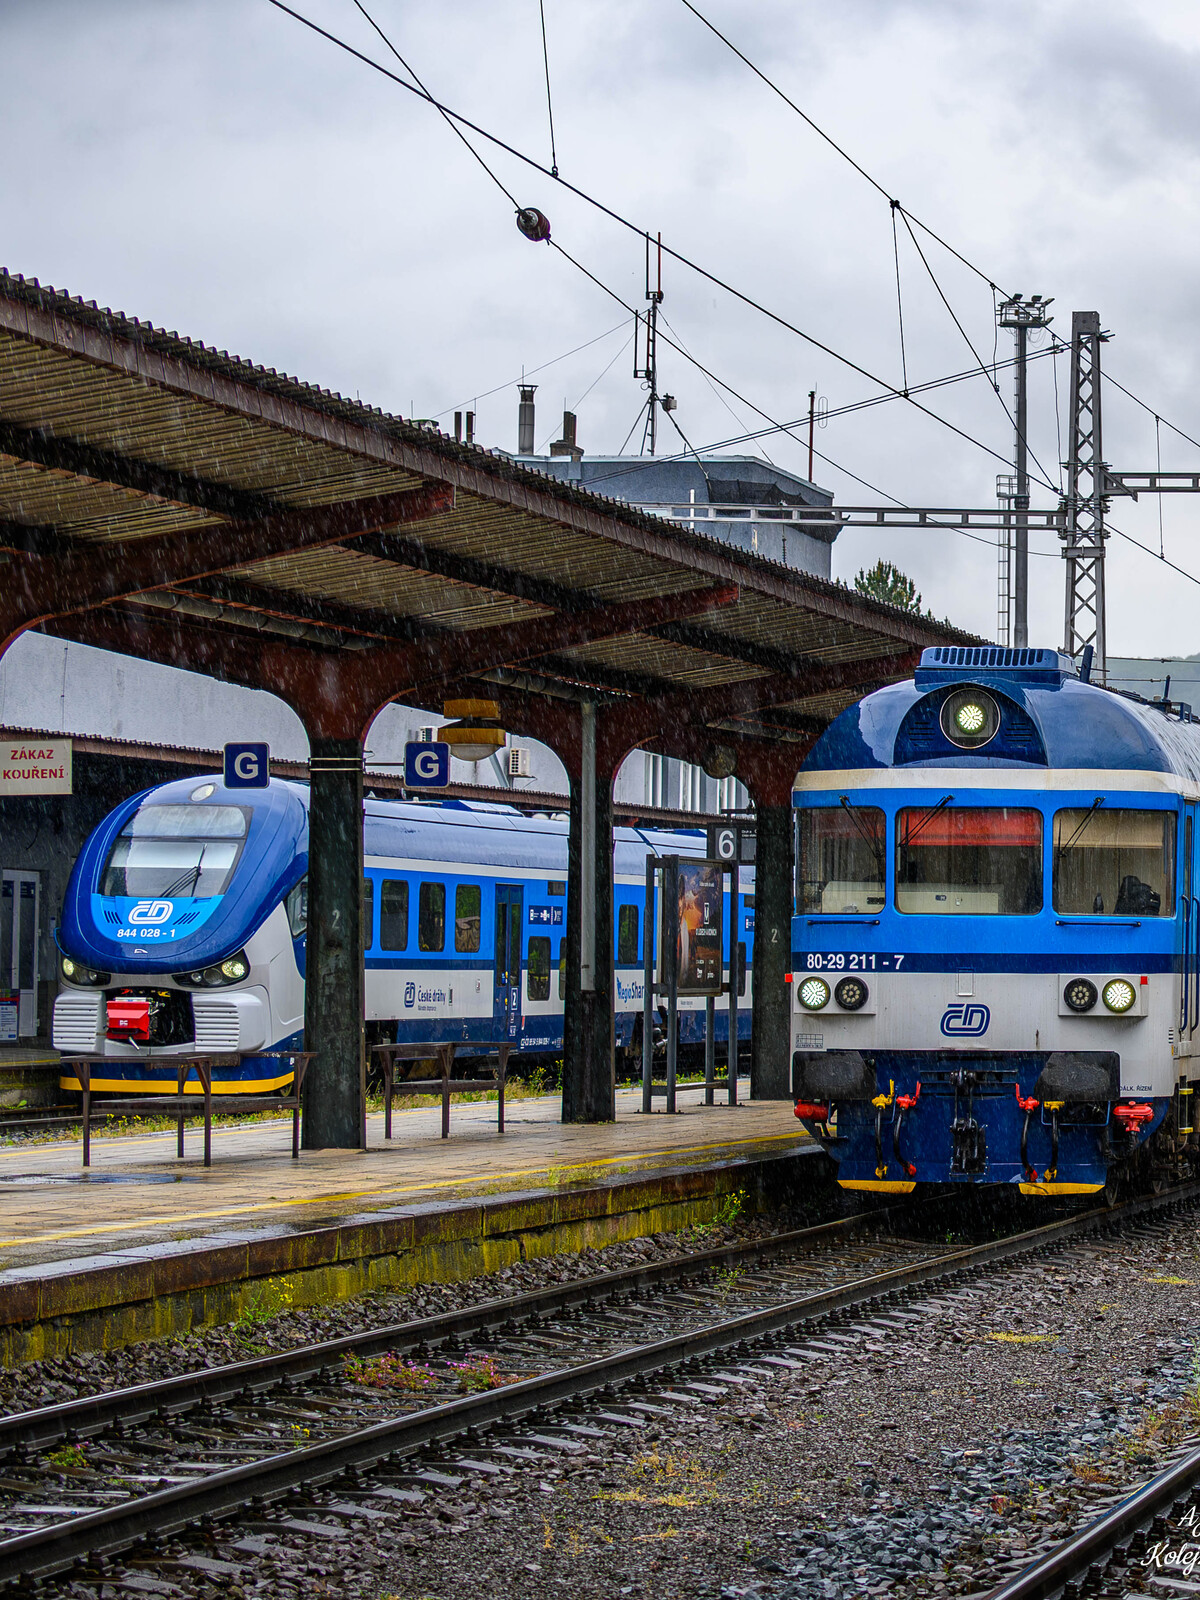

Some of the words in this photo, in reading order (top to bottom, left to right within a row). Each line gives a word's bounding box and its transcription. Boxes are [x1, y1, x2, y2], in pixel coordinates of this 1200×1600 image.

[11, 746, 54, 760] ZÁKAZ
[3, 765, 65, 780] KOUŘENÍ
[234, 752, 259, 779] G
[414, 751, 439, 778] G
[718, 830, 735, 859] 6
[117, 928, 137, 938] 844
[140, 928, 161, 938] 028
[170, 928, 176, 938] 1
[771, 928, 778, 943] 2
[806, 954, 845, 969] 80-29
[849, 954, 876, 969] 211
[894, 954, 905, 970] 7
[616, 976, 645, 1003] RegioShar
